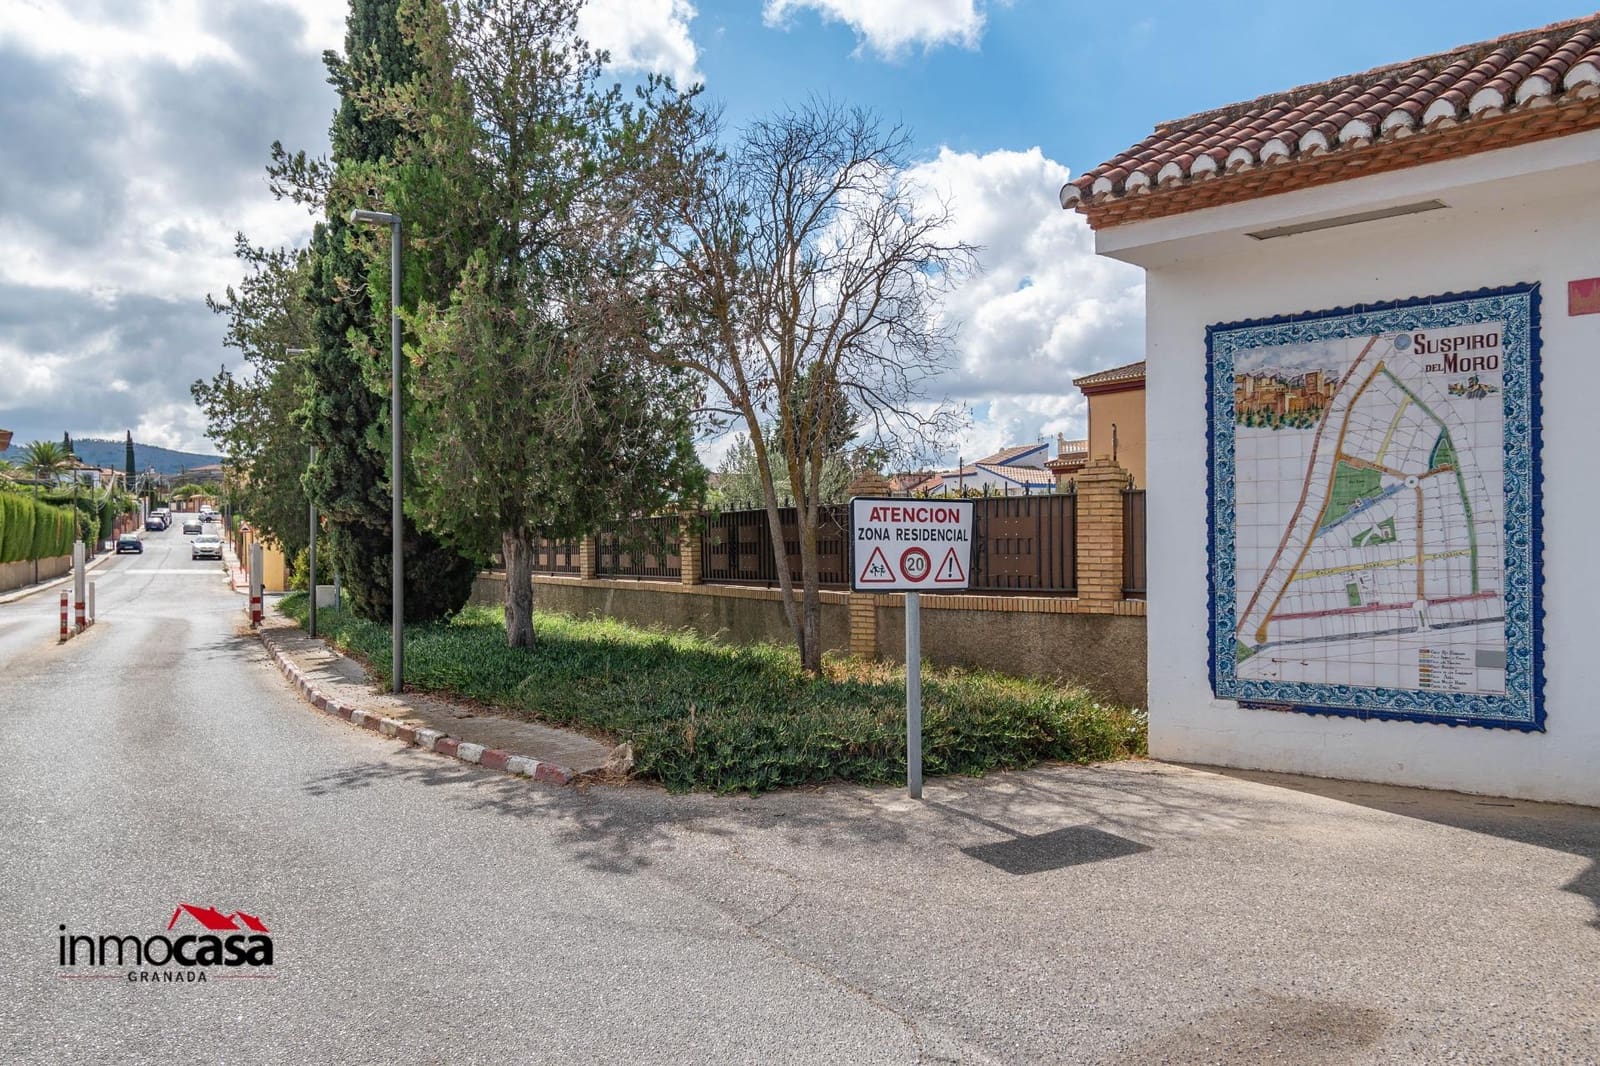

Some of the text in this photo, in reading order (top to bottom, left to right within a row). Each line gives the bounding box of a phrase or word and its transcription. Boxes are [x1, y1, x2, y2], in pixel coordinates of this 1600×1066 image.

[1414, 333, 1498, 355] SUSPIRO
[1425, 353, 1499, 374] DEL MORO
[869, 507, 960, 523] ATENCION
[858, 528, 968, 541] ZONA RESIDENCIAL
[907, 557, 924, 571] 20
